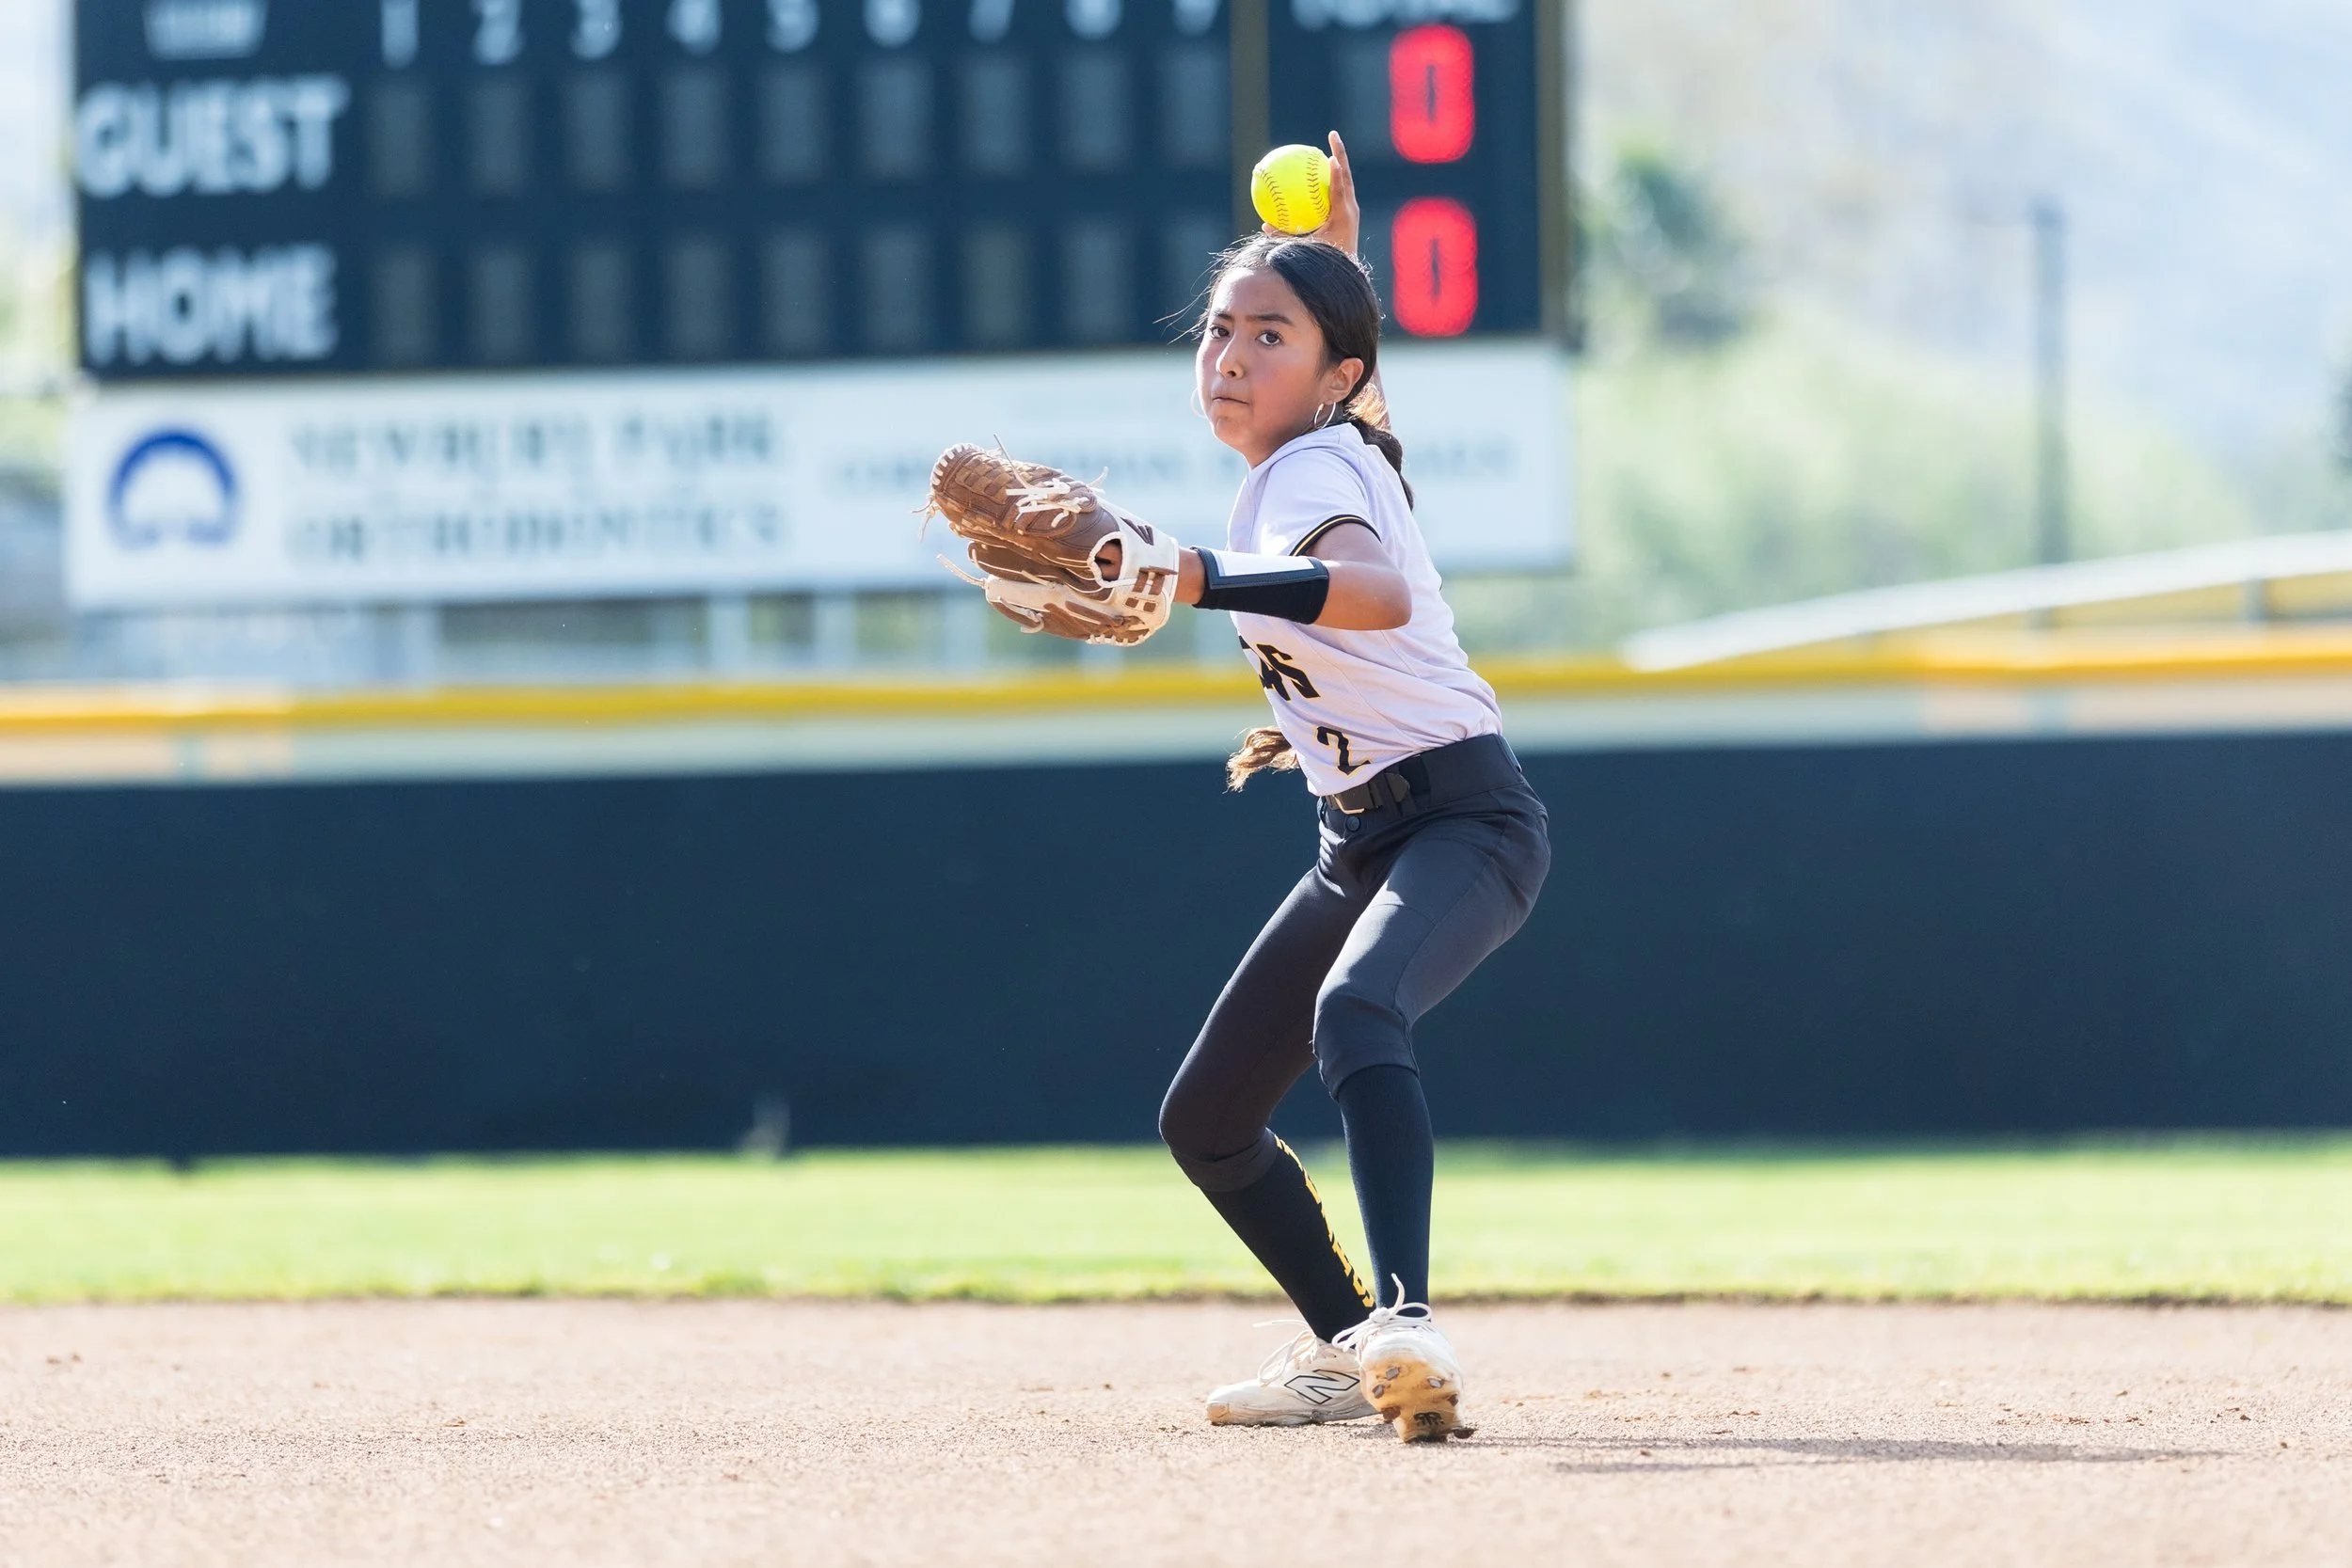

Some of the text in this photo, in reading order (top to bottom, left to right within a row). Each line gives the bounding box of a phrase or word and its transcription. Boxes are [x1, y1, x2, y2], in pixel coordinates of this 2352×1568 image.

[75, 75, 349, 198] GUEST
[1389, 24, 1475, 165] 0
[85, 242, 339, 366] HOME
[1391, 196, 1478, 338] 0
[1316, 725, 1373, 776] 2
